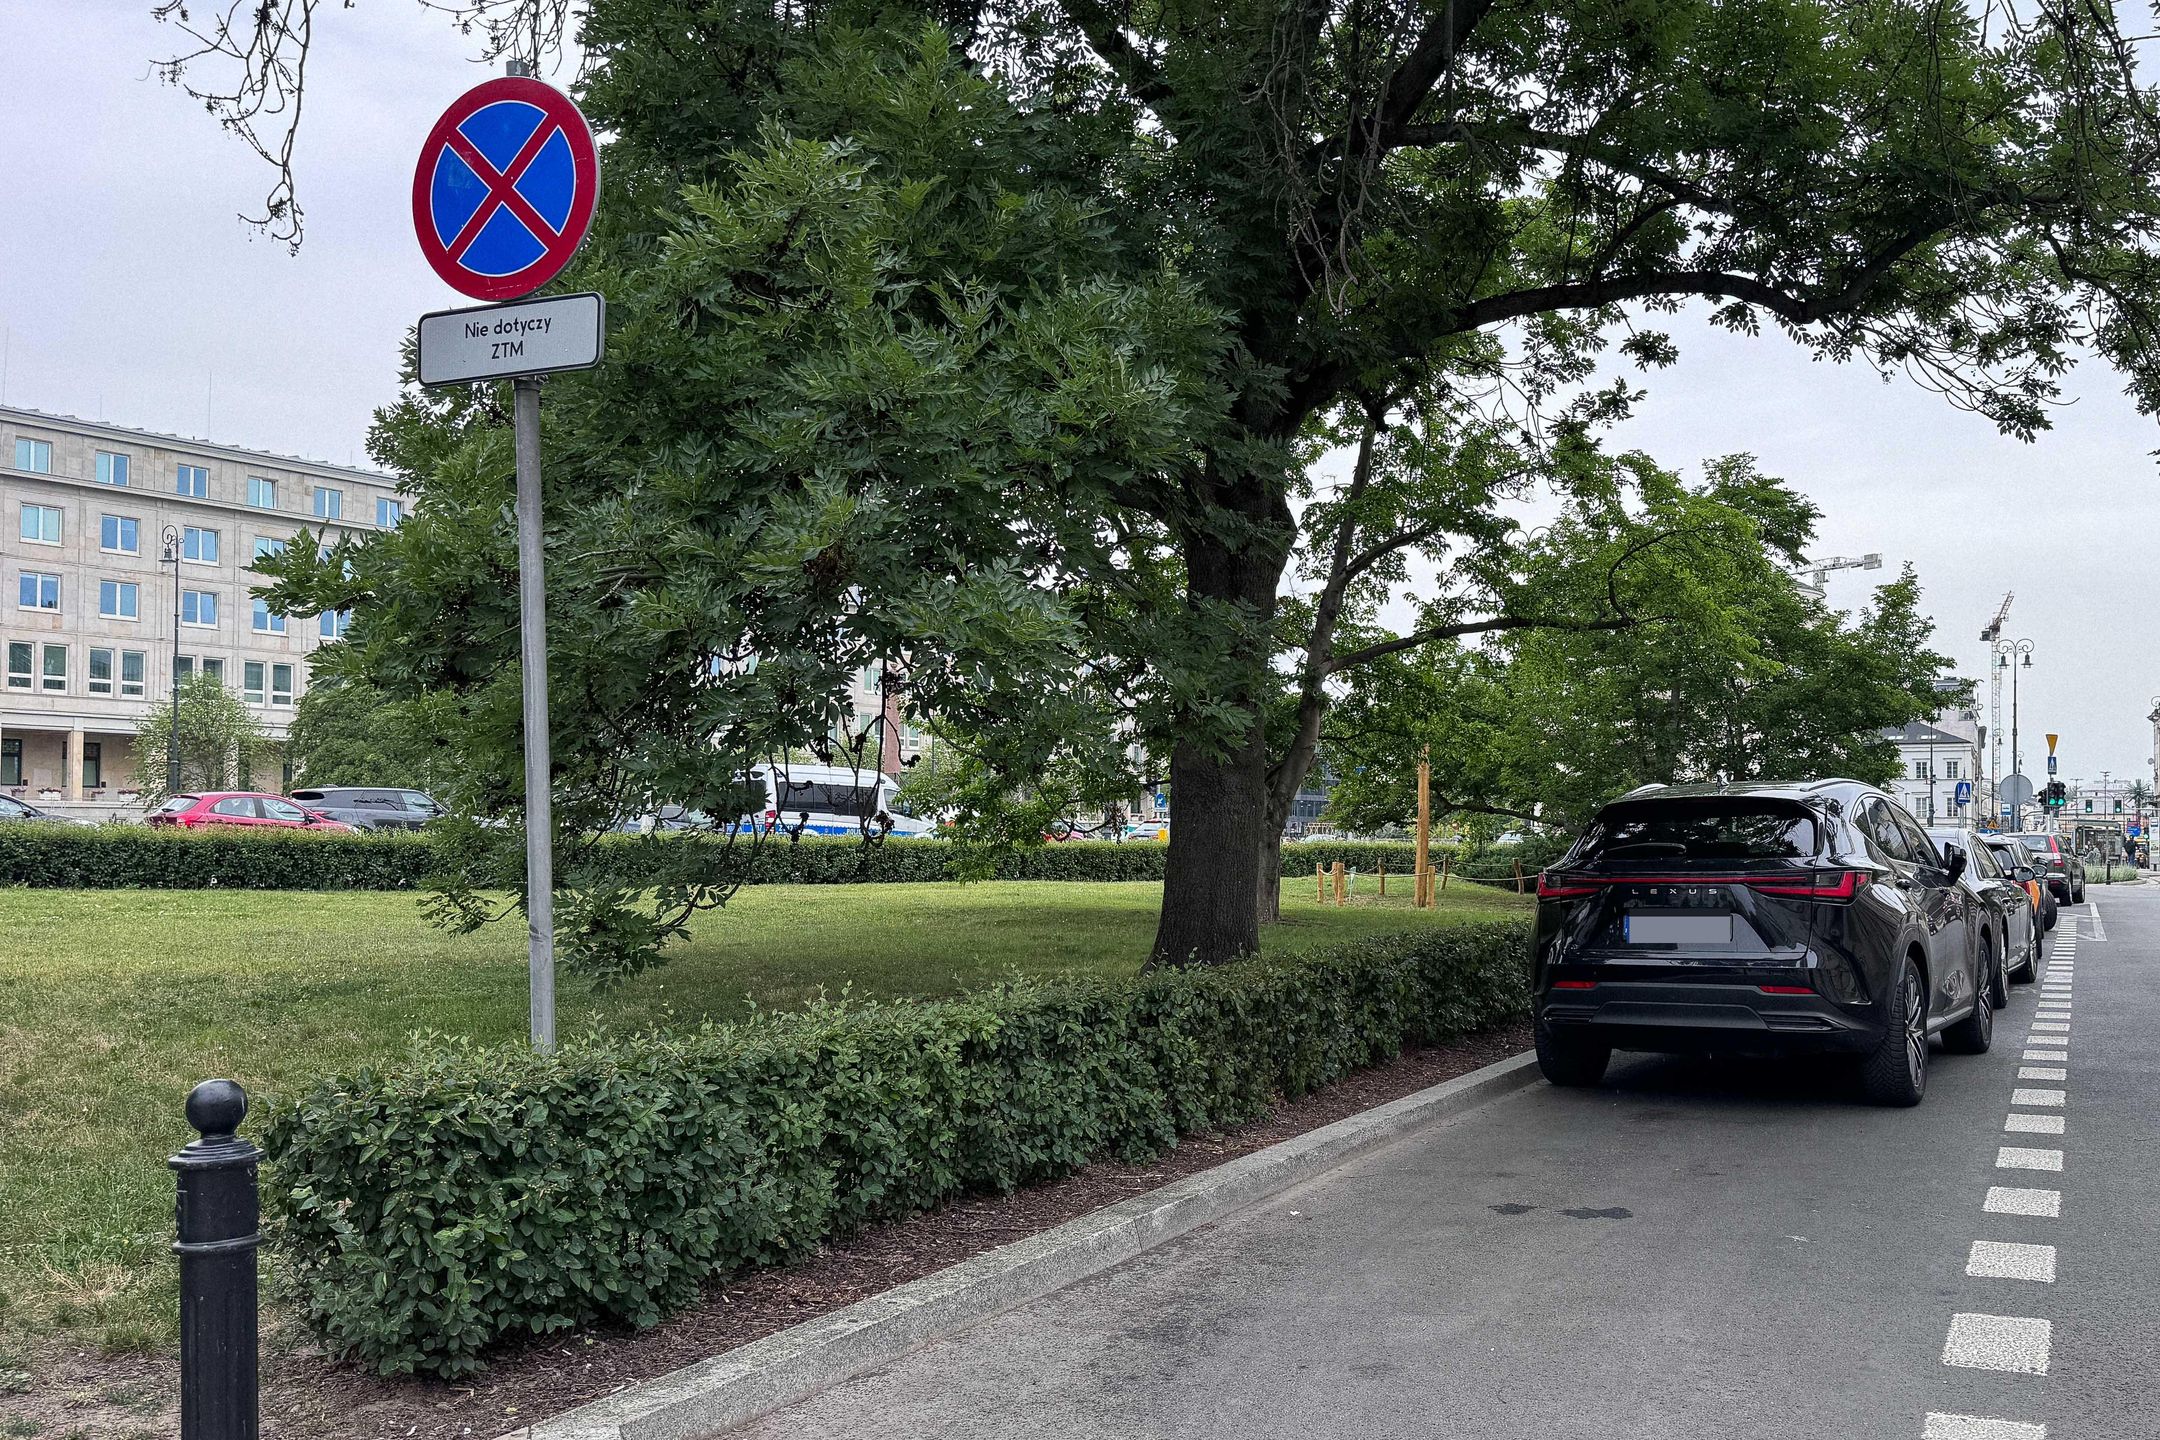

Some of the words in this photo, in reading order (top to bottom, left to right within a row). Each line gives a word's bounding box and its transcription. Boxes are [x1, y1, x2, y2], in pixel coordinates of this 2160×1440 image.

[465, 321, 489, 339] Nie
[493, 316, 552, 337] dotyczy
[491, 340, 524, 360] ZTM
